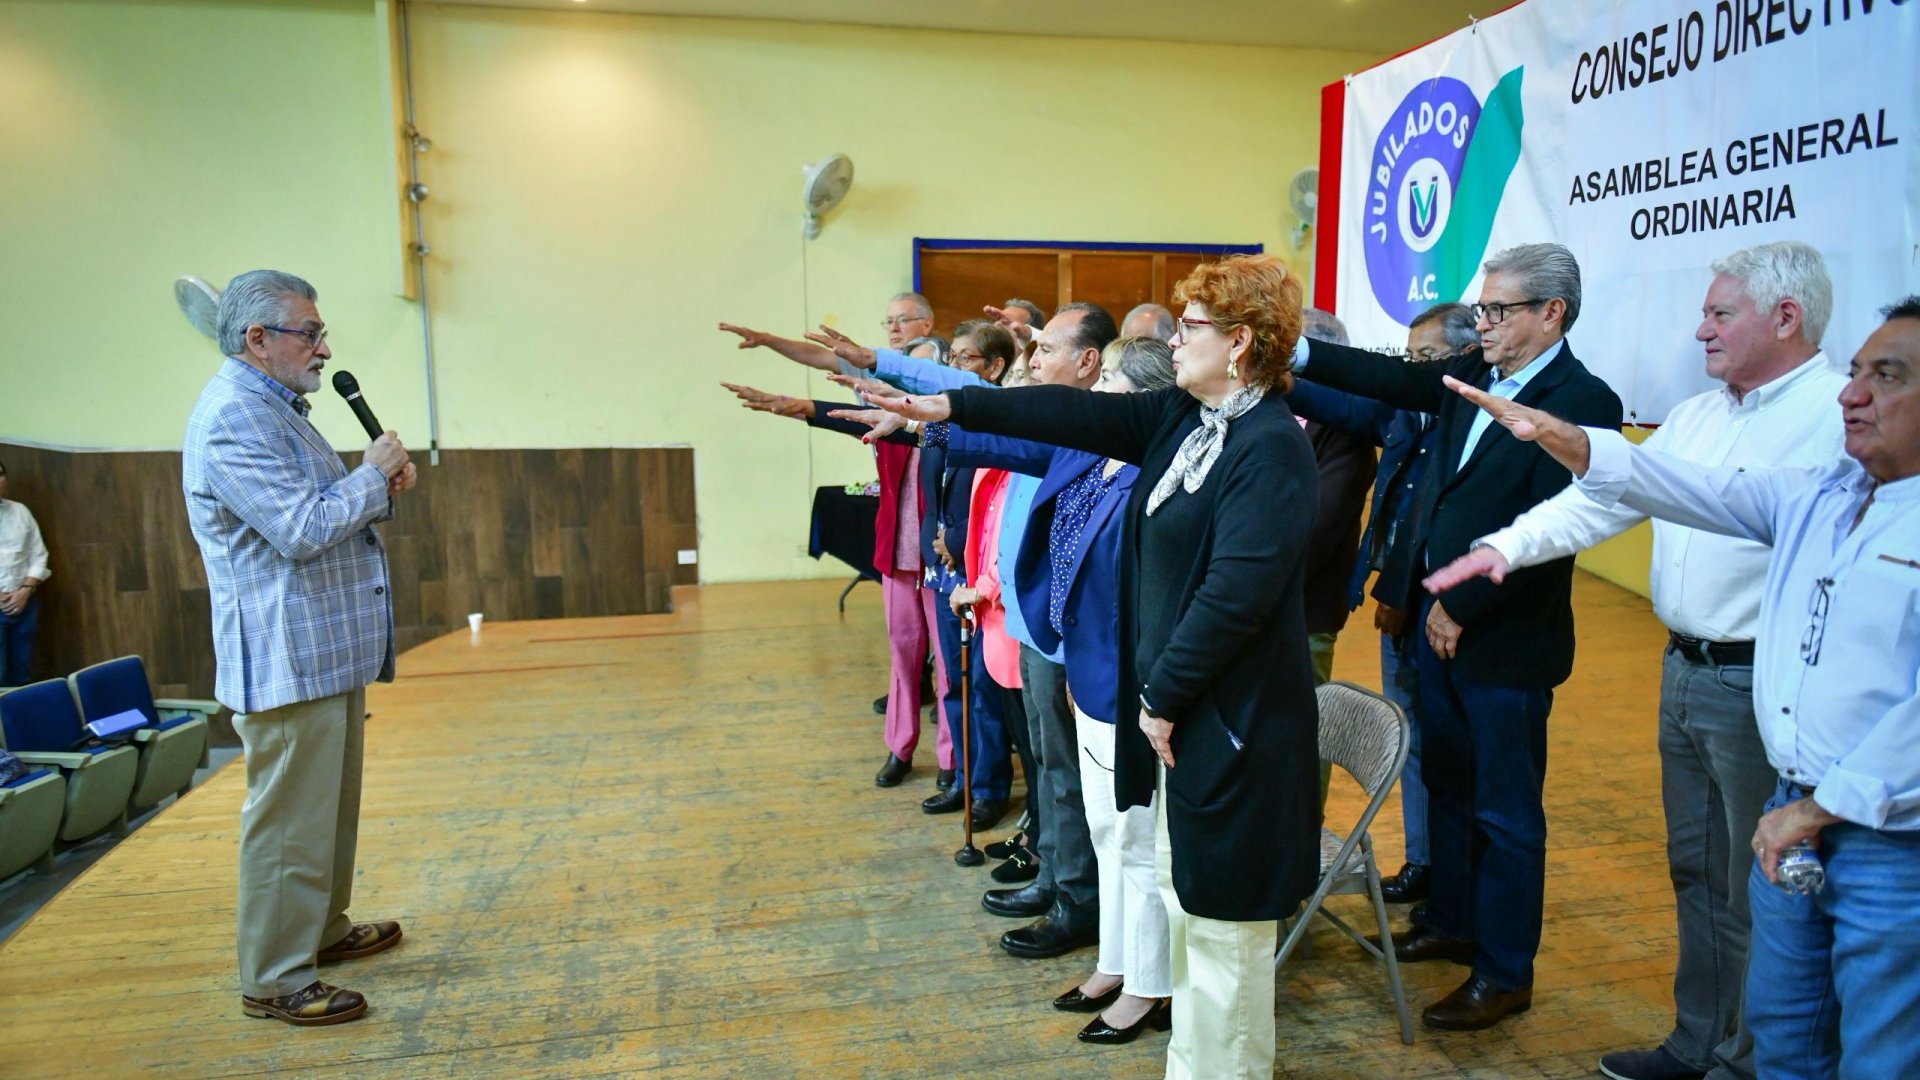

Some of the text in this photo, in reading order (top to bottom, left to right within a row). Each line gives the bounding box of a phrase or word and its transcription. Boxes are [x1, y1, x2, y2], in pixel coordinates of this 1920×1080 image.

[1571, 0, 1911, 104] CONSEJO DIREC
[1370, 101, 1469, 245] JUBILADOS
[1568, 108, 1899, 206] ASAMBLEA GENERAL
[1630, 184, 1796, 241] ORDINARIA
[1407, 273, 1439, 302] A.C.
